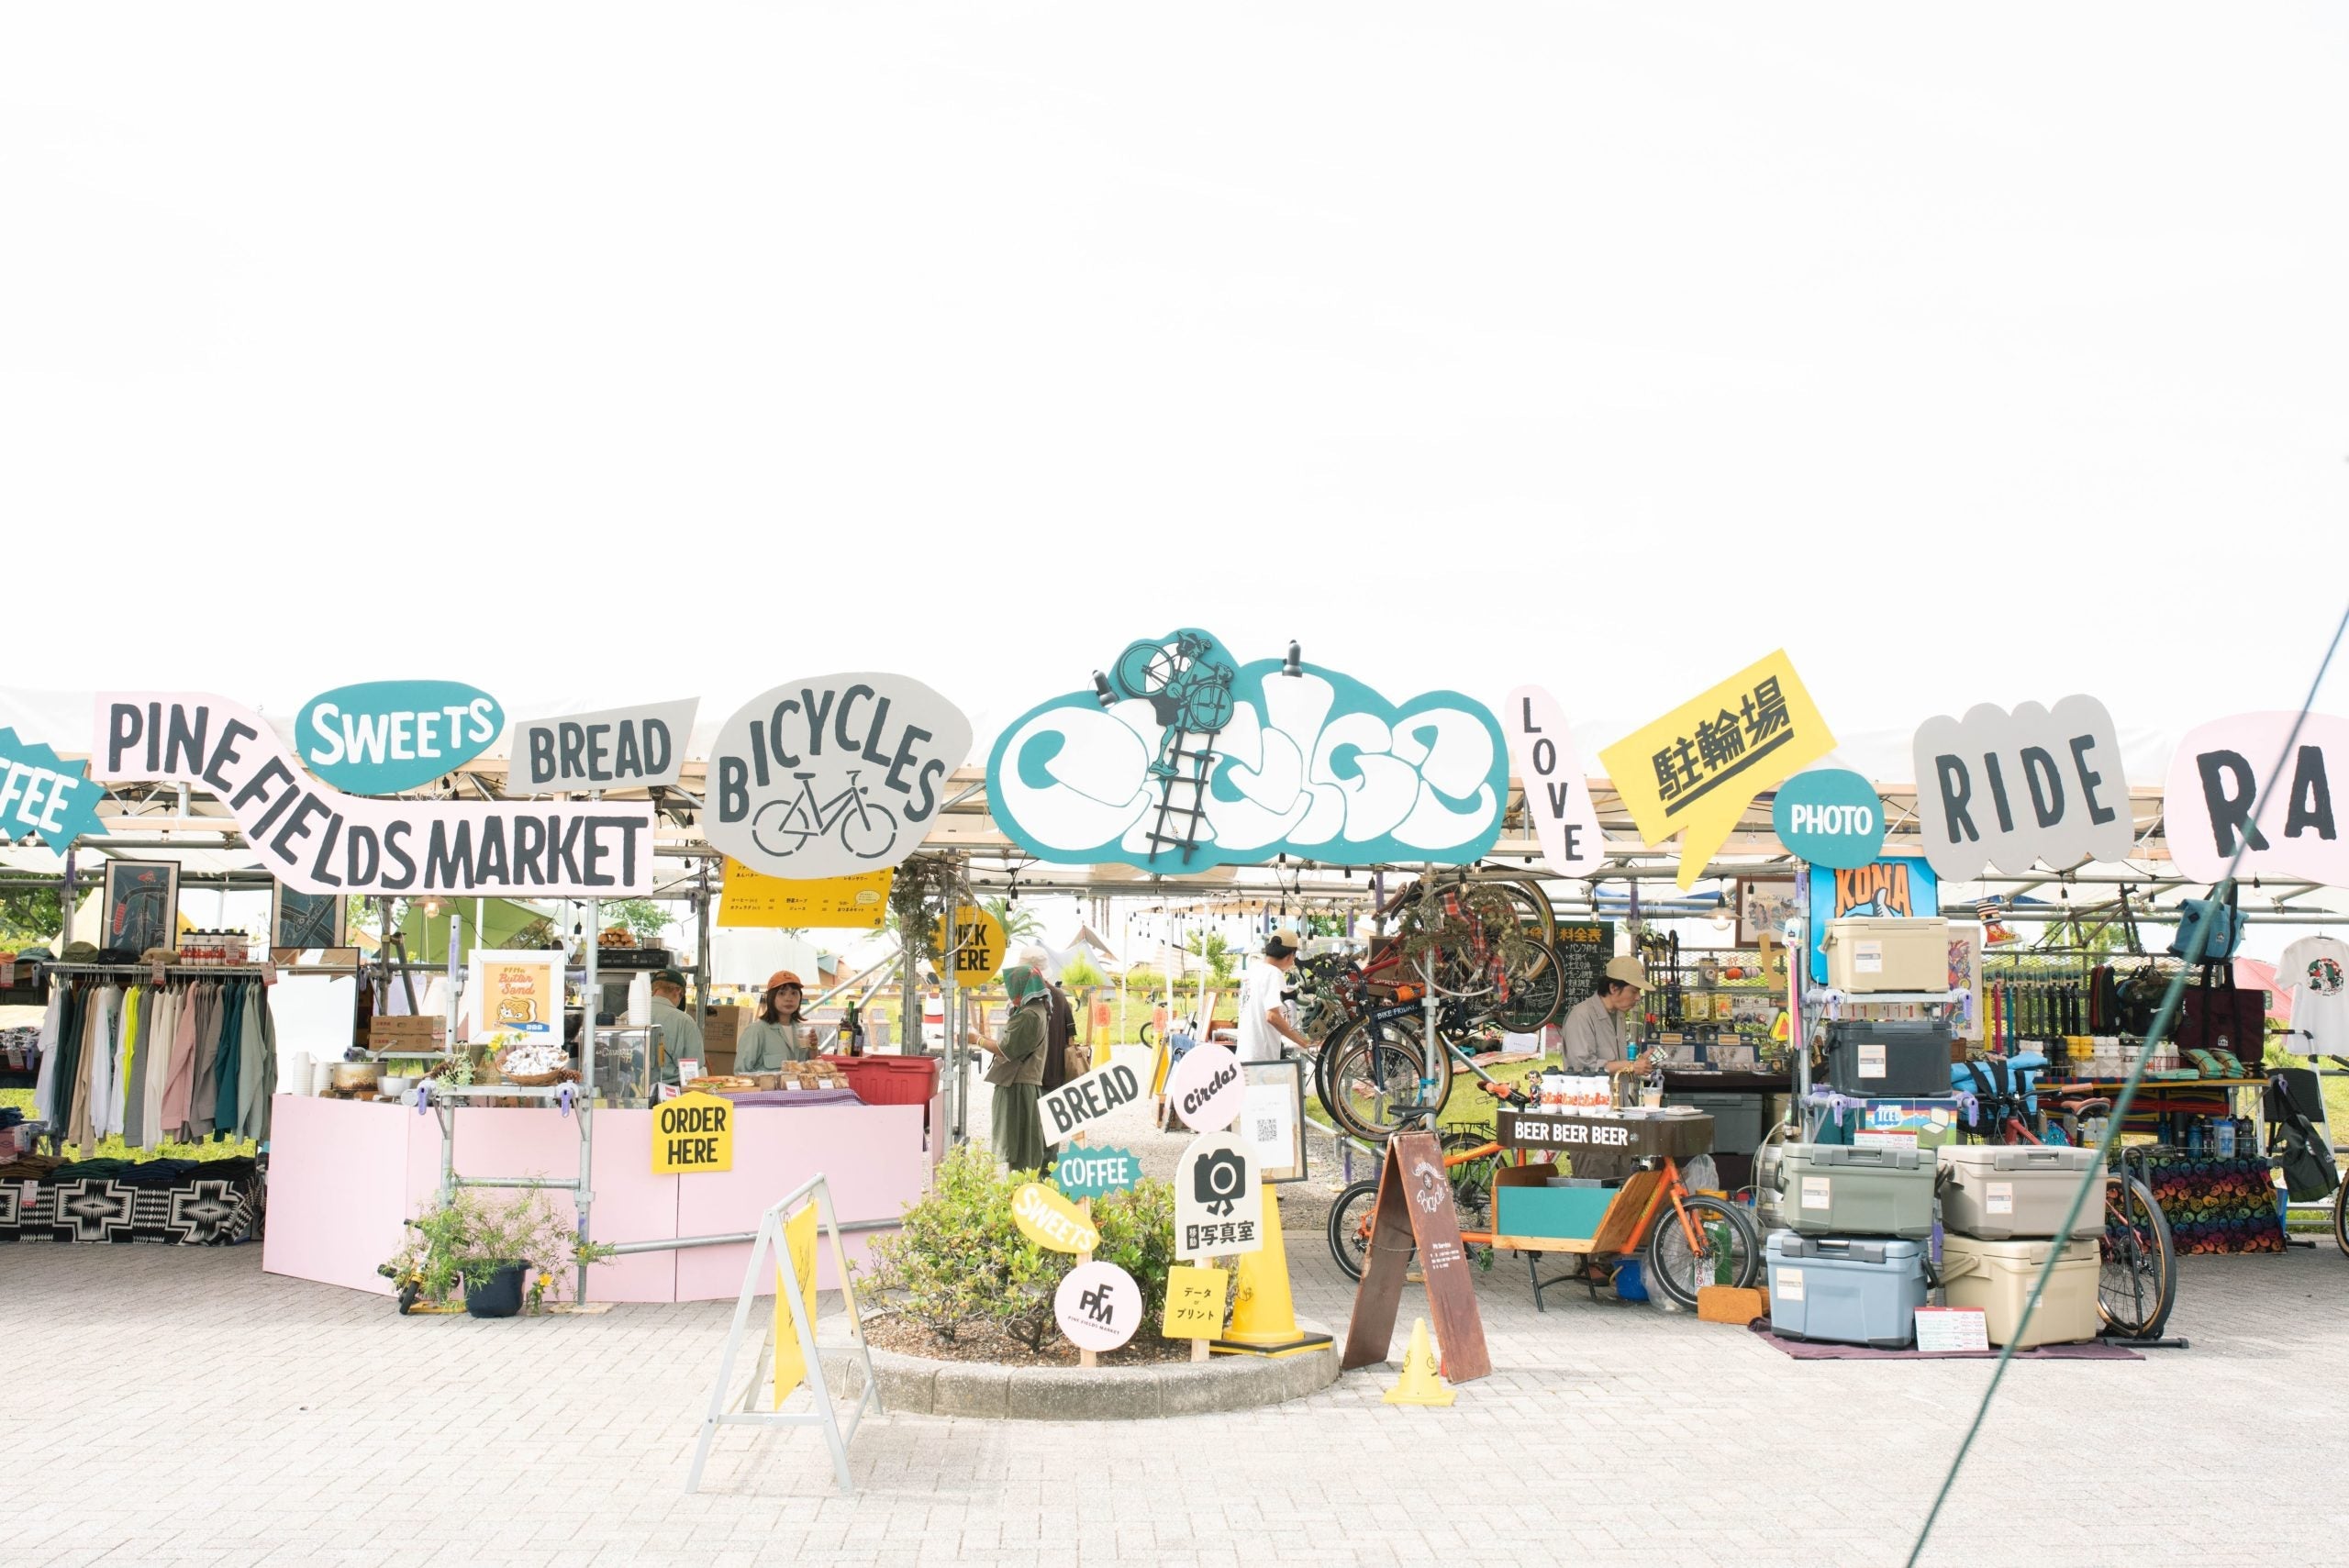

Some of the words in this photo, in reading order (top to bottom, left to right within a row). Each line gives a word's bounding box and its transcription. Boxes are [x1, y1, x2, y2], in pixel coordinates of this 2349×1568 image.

[529, 717, 672, 784] BREAD
[1652, 674, 1791, 802] 駐輪場
[718, 684, 945, 823] BICYCLES
[1522, 696, 1584, 862] LOVE
[1934, 734, 2116, 844] RIDE
[0, 756, 80, 834] FEE
[108, 701, 258, 794] PINE
[229, 755, 417, 890] FIELDS
[423, 815, 649, 890] MARKET
[1791, 804, 1873, 836] PHOTO
[1834, 862, 1913, 917] KONA
[955, 924, 987, 947] ICK
[944, 949, 991, 972] ERE
[498, 973, 533, 984] Butter
[501, 983, 535, 995] Sand
[1377, 1009, 1393, 1020] BIKE
[1047, 1064, 1139, 1134] BREAD
[1183, 1062, 1238, 1115] Circles
[661, 1106, 727, 1134] ORDER
[1515, 1121, 1550, 1141] BEER
[1553, 1124, 1588, 1144] BEER
[1591, 1126, 1629, 1146] BEER
[667, 1138, 718, 1165] HERE
[1061, 1157, 1130, 1188] COFFEE
[1188, 1228, 1197, 1247] 移動
[1200, 1220, 1255, 1247] 写真室
[1184, 1286, 1212, 1298] データ
[1080, 1319, 1098, 1329] FIELDS
[1098, 1325, 1120, 1336] MARKET
[1177, 1308, 1215, 1321] プリント
